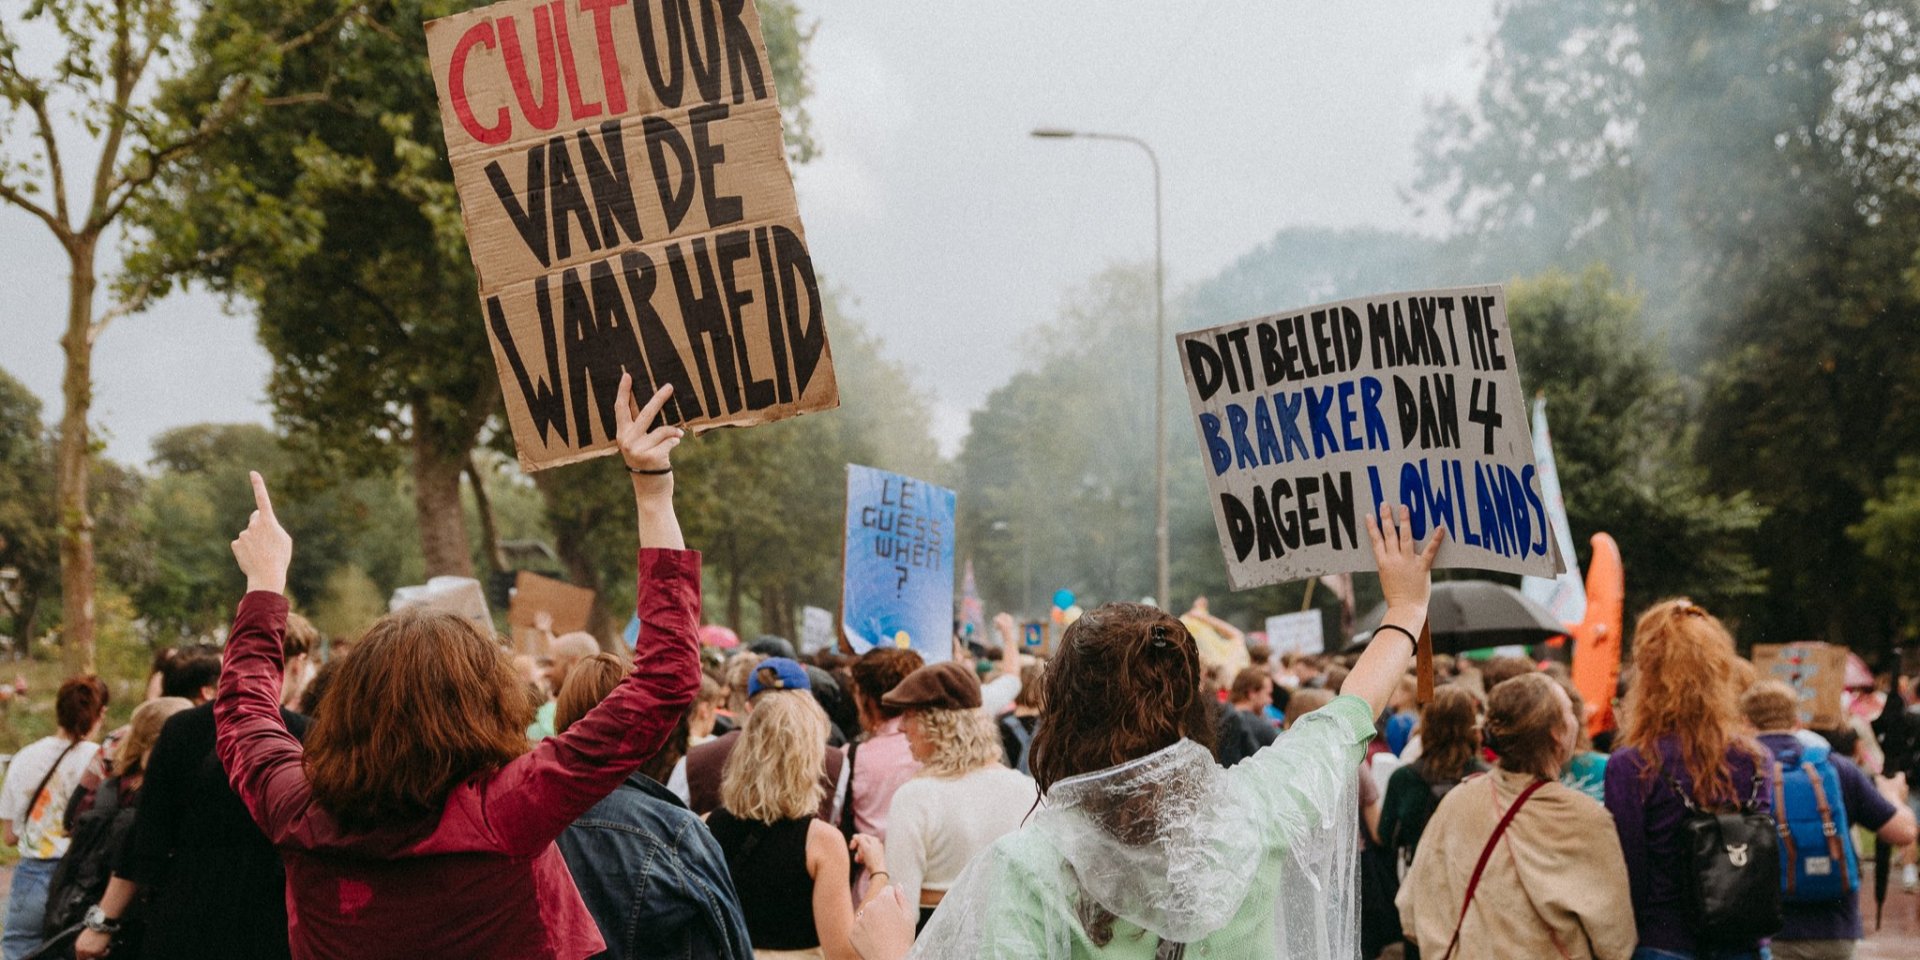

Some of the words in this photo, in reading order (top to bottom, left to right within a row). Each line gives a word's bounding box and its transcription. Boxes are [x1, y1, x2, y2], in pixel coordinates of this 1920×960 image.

[449, 0, 768, 146] CULTUUR
[484, 120, 643, 268] VAN
[643, 103, 744, 233] DE
[487, 225, 826, 449] WAARHEID
[1184, 327, 1255, 402] DIT
[1256, 306, 1363, 386] BELEID
[1367, 296, 1460, 370] MAAKT
[1461, 295, 1507, 371] ME
[1199, 376, 1390, 476] BRAKKER
[1393, 372, 1461, 450] DAN
[1468, 378, 1502, 455] 4
[862, 505, 943, 547] GUESS
[881, 479, 915, 510] LE
[1220, 471, 1358, 563] DAGEN
[1367, 458, 1548, 562] LOWLANDS
[875, 535, 940, 571] WHEN
[895, 566, 908, 599] ?
